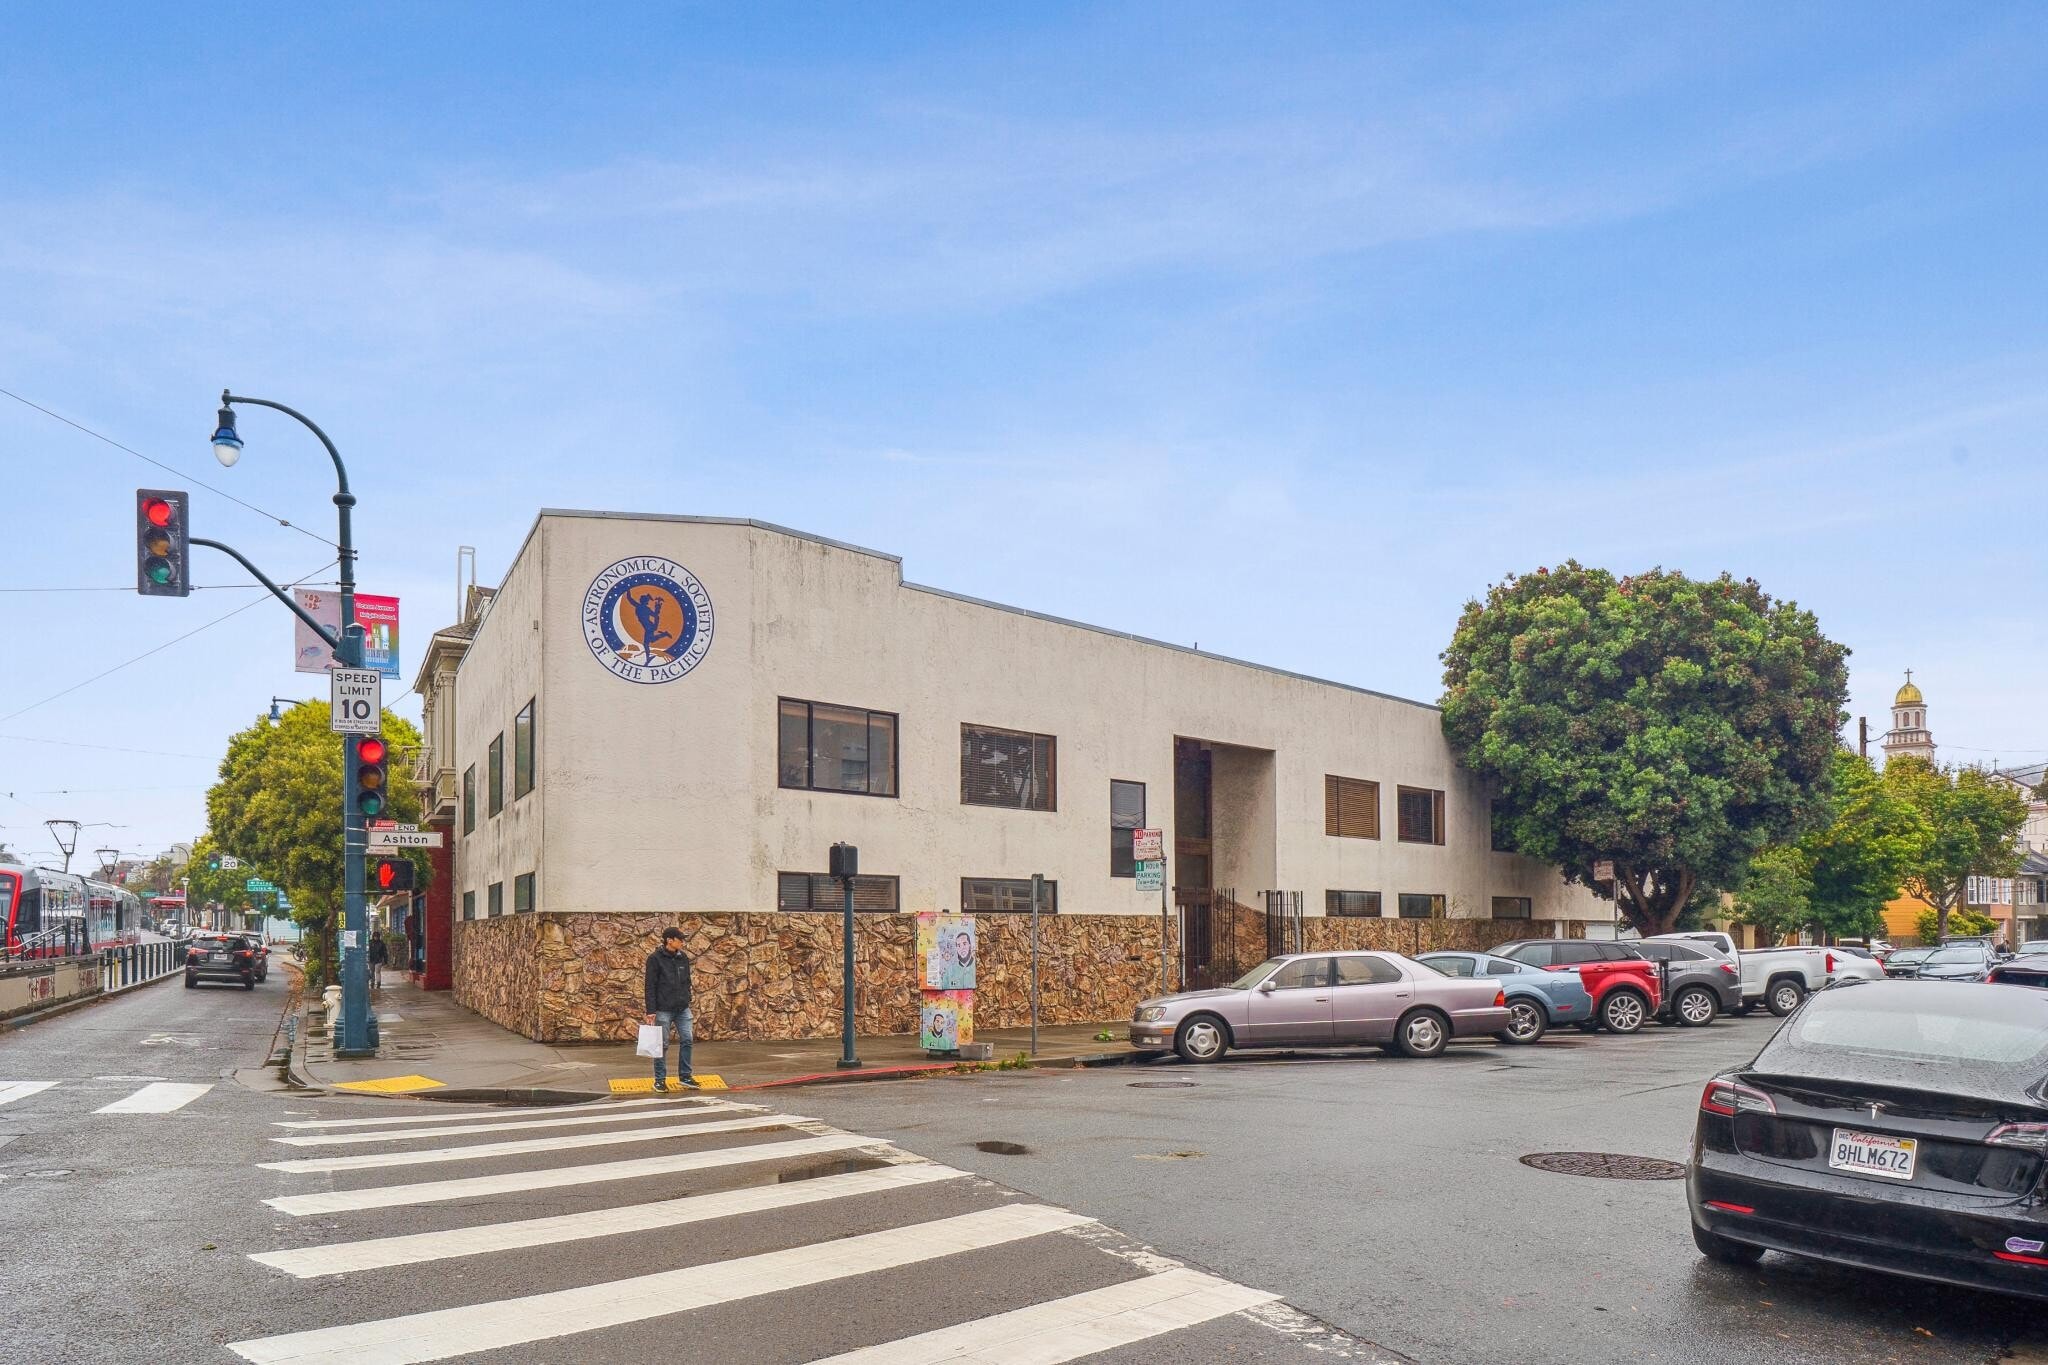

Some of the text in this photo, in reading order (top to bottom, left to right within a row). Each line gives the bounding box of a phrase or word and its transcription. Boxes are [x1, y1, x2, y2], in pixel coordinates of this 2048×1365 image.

[585, 559, 710, 638] ASTRONOMICAL SOCIETY
[591, 637, 704, 681] OF THE PACIFIC
[336, 673, 377, 684] SPEED
[340, 686, 373, 696] LIMIT
[342, 699, 370, 720] 10
[383, 834, 428, 844] Ashton
[1135, 830, 1143, 839] NO
[1850, 1134, 1899, 1148] California
[1837, 1143, 1909, 1170] 8HLM672
